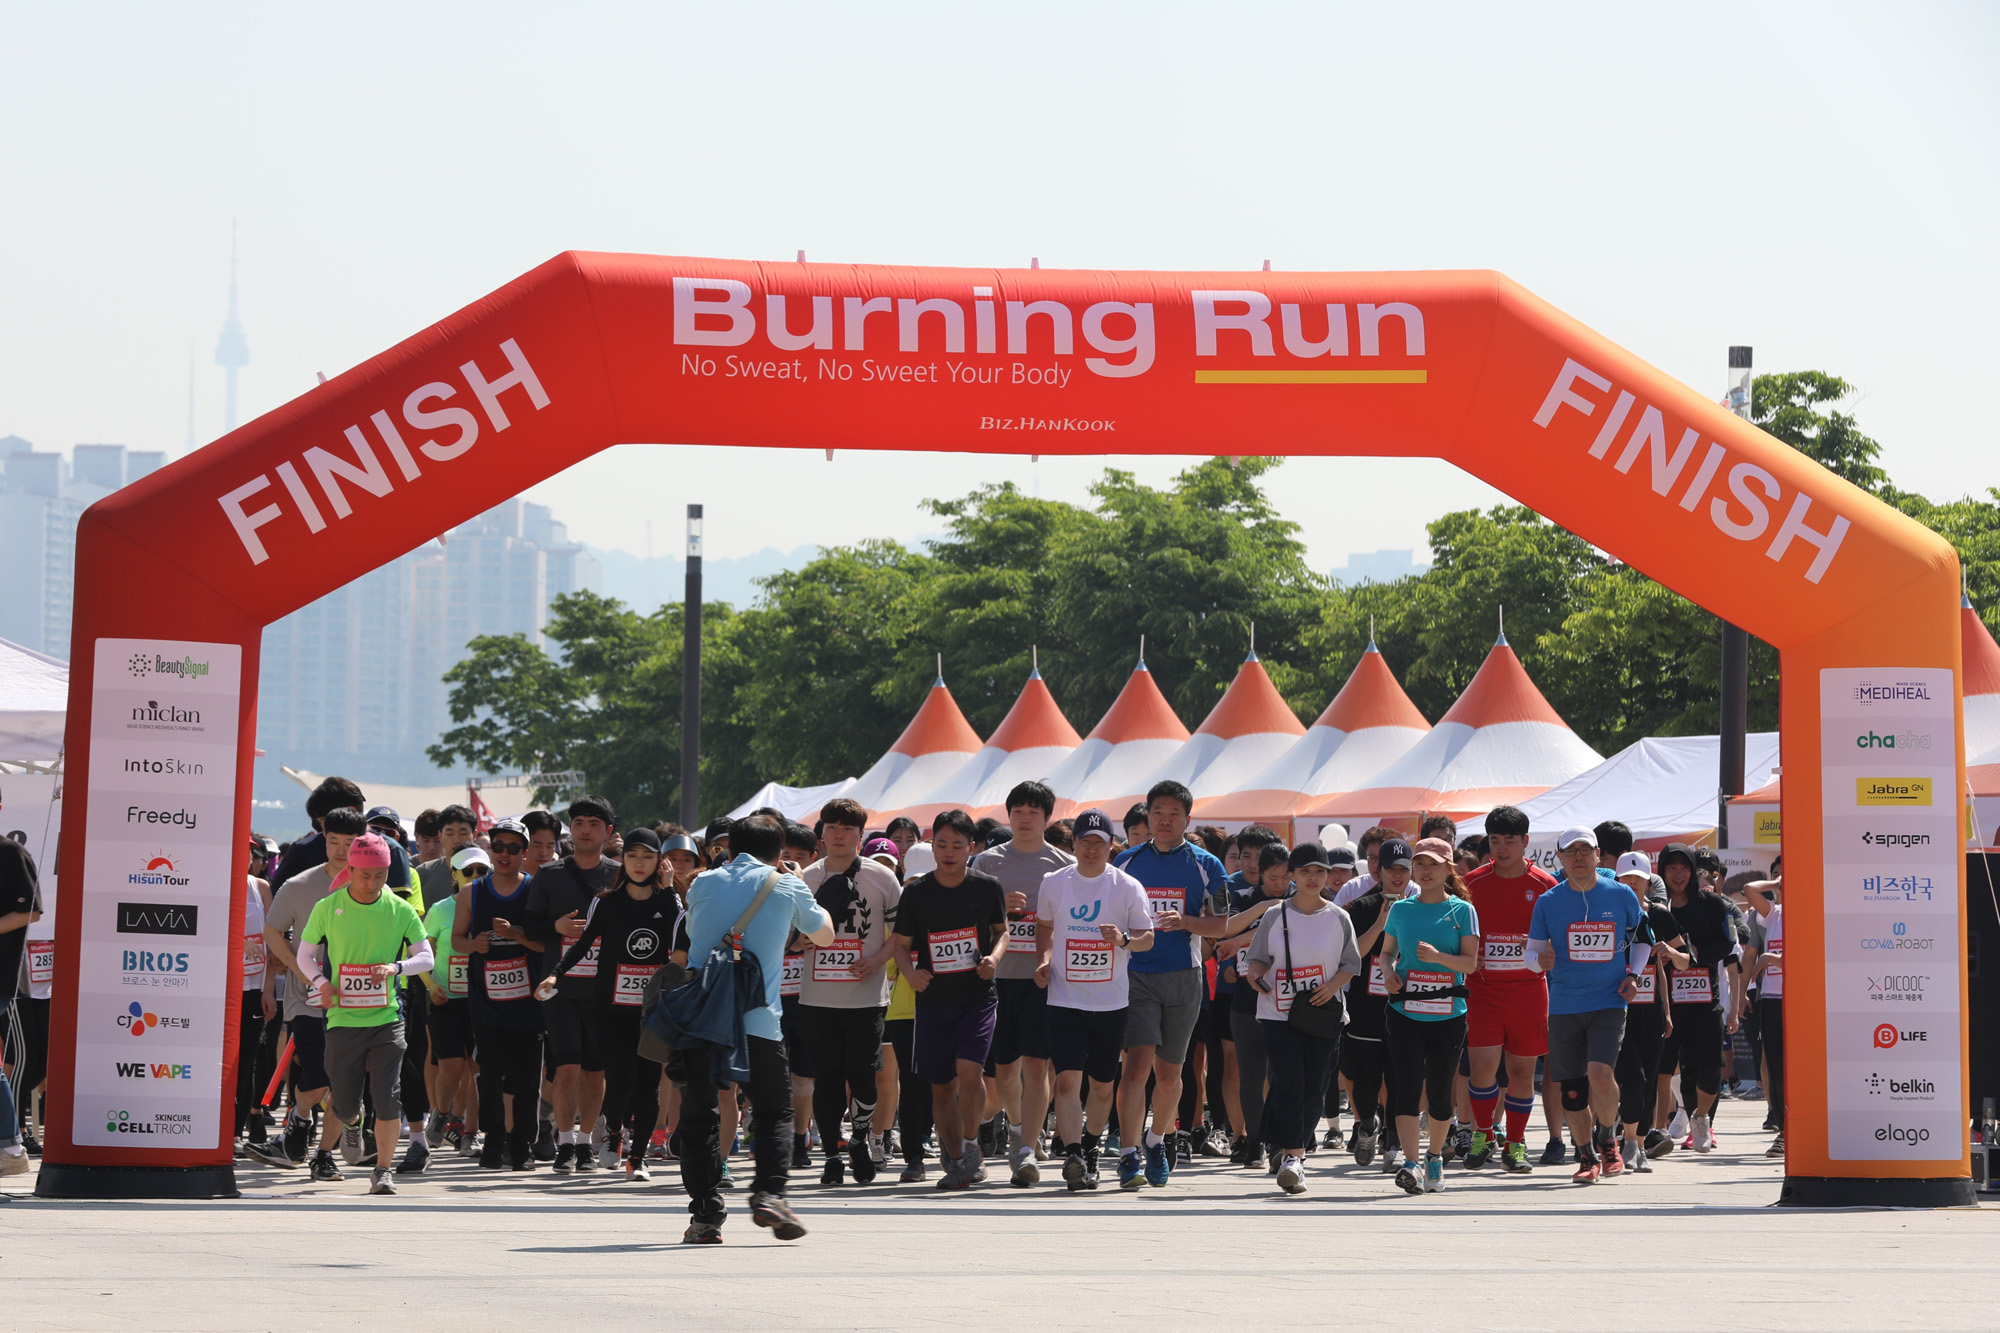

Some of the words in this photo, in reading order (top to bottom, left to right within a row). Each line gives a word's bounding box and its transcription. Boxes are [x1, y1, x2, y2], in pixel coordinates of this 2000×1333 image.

[672, 277, 1156, 378] Burning
[1191, 290, 1426, 359] Run
[681, 353, 717, 377] No
[725, 355, 809, 383] Sweat,
[818, 358, 854, 380] No
[861, 359, 938, 384] Sweet
[945, 361, 1005, 385] Your
[1011, 362, 1072, 389] Body
[217, 337, 552, 566] FINISH
[1532, 357, 1851, 585] FINISH
[1860, 687, 1931, 700] MEDIHEAL
[132, 703, 201, 724] miclan
[1856, 730, 1931, 749] chacha
[1867, 784, 1909, 795] Jabra
[127, 806, 197, 829] Freedy
[1875, 834, 1930, 848] spigen
[128, 873, 190, 887] HisunTour
[1862, 875, 1934, 901] 비즈한국
[1010, 923, 1036, 937] 268
[1570, 923, 1598, 931] Burning
[930, 932, 959, 941] Burning
[959, 929, 974, 937] Run
[1486, 934, 1511, 942] Burning
[1574, 934, 1609, 946] 3077
[935, 941, 973, 958] 2012
[1069, 941, 1097, 949] Burning
[1489, 945, 1523, 957] 2928
[122, 950, 189, 973] BROS
[486, 961, 513, 969] Burning
[512, 959, 525, 967] Run
[819, 952, 855, 965] 2422
[1071, 952, 1108, 966] 2525
[342, 965, 370, 975] Burning
[620, 965, 649, 974] Burning
[1305, 967, 1320, 975] Run
[1410, 971, 1438, 981] Burning
[122, 976, 149, 986] 브로스
[163, 977, 189, 988] 안마기
[490, 970, 525, 985] 2803
[621, 977, 649, 990] 258
[1676, 978, 1707, 990] 2520
[1885, 993, 1904, 1001] 스마트
[1905, 993, 1922, 1002] 체중계
[117, 1015, 133, 1029] CJ
[160, 1017, 190, 1029] 푸드빌
[1900, 1031, 1927, 1041] LIFE
[116, 1062, 146, 1078] WE
[150, 1063, 192, 1080] VAPE
[1889, 1078, 1935, 1093] belkin
[155, 1113, 191, 1122] SKINCURE
[118, 1122, 191, 1135] CELLTRION
[1874, 1123, 1930, 1147] elago
